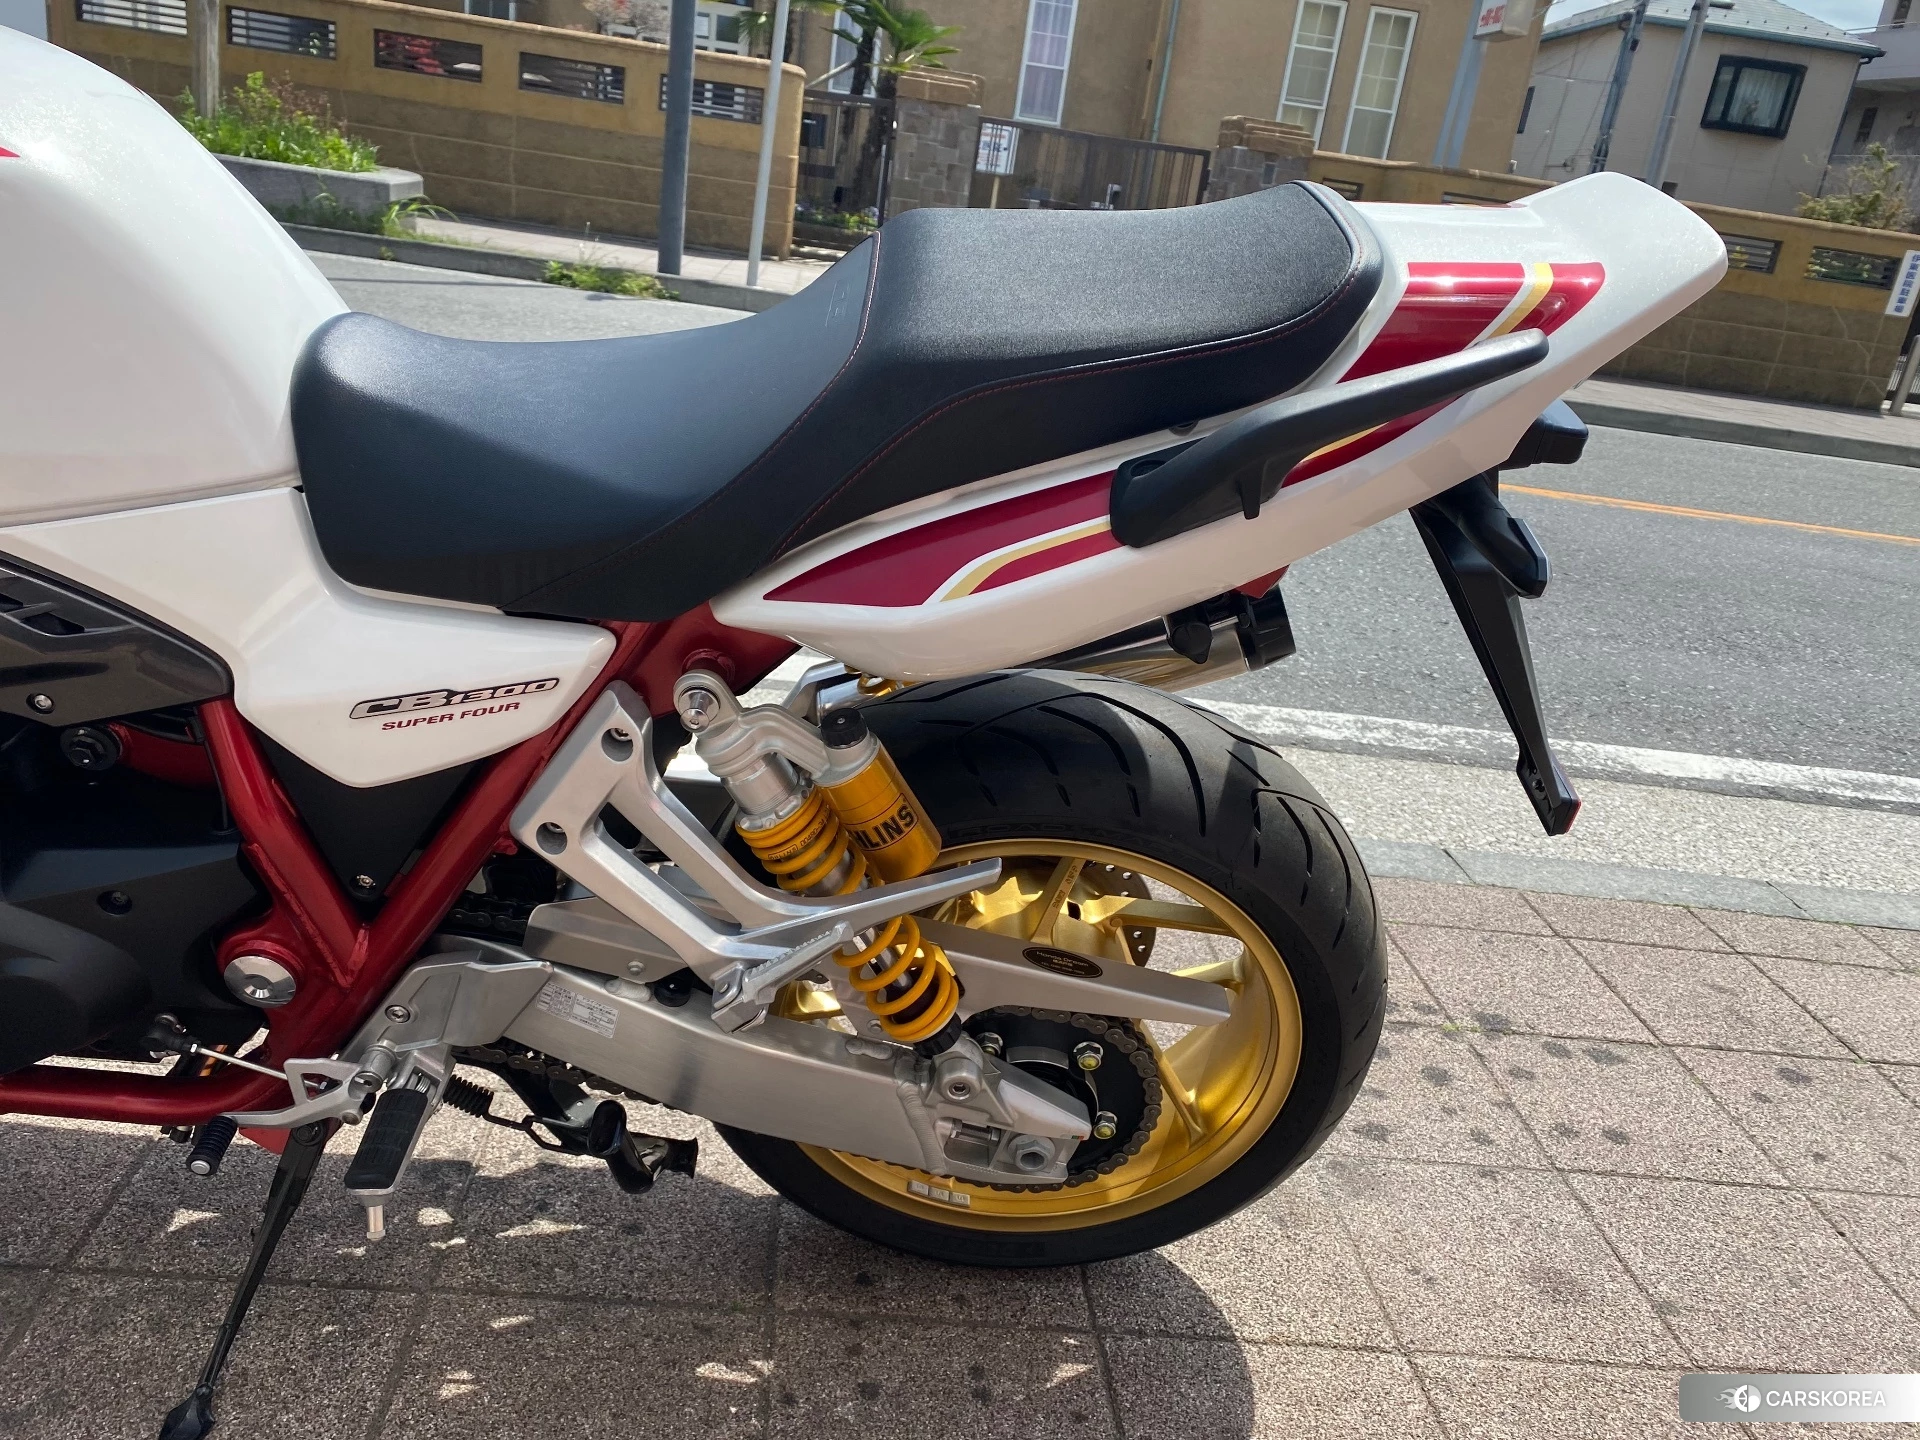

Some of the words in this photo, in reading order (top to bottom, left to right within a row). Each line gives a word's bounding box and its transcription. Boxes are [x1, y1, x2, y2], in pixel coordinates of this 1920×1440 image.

[349, 678, 560, 720] CB1300
[381, 713, 454, 731] SUPER
[460, 702, 521, 720] FOUR
